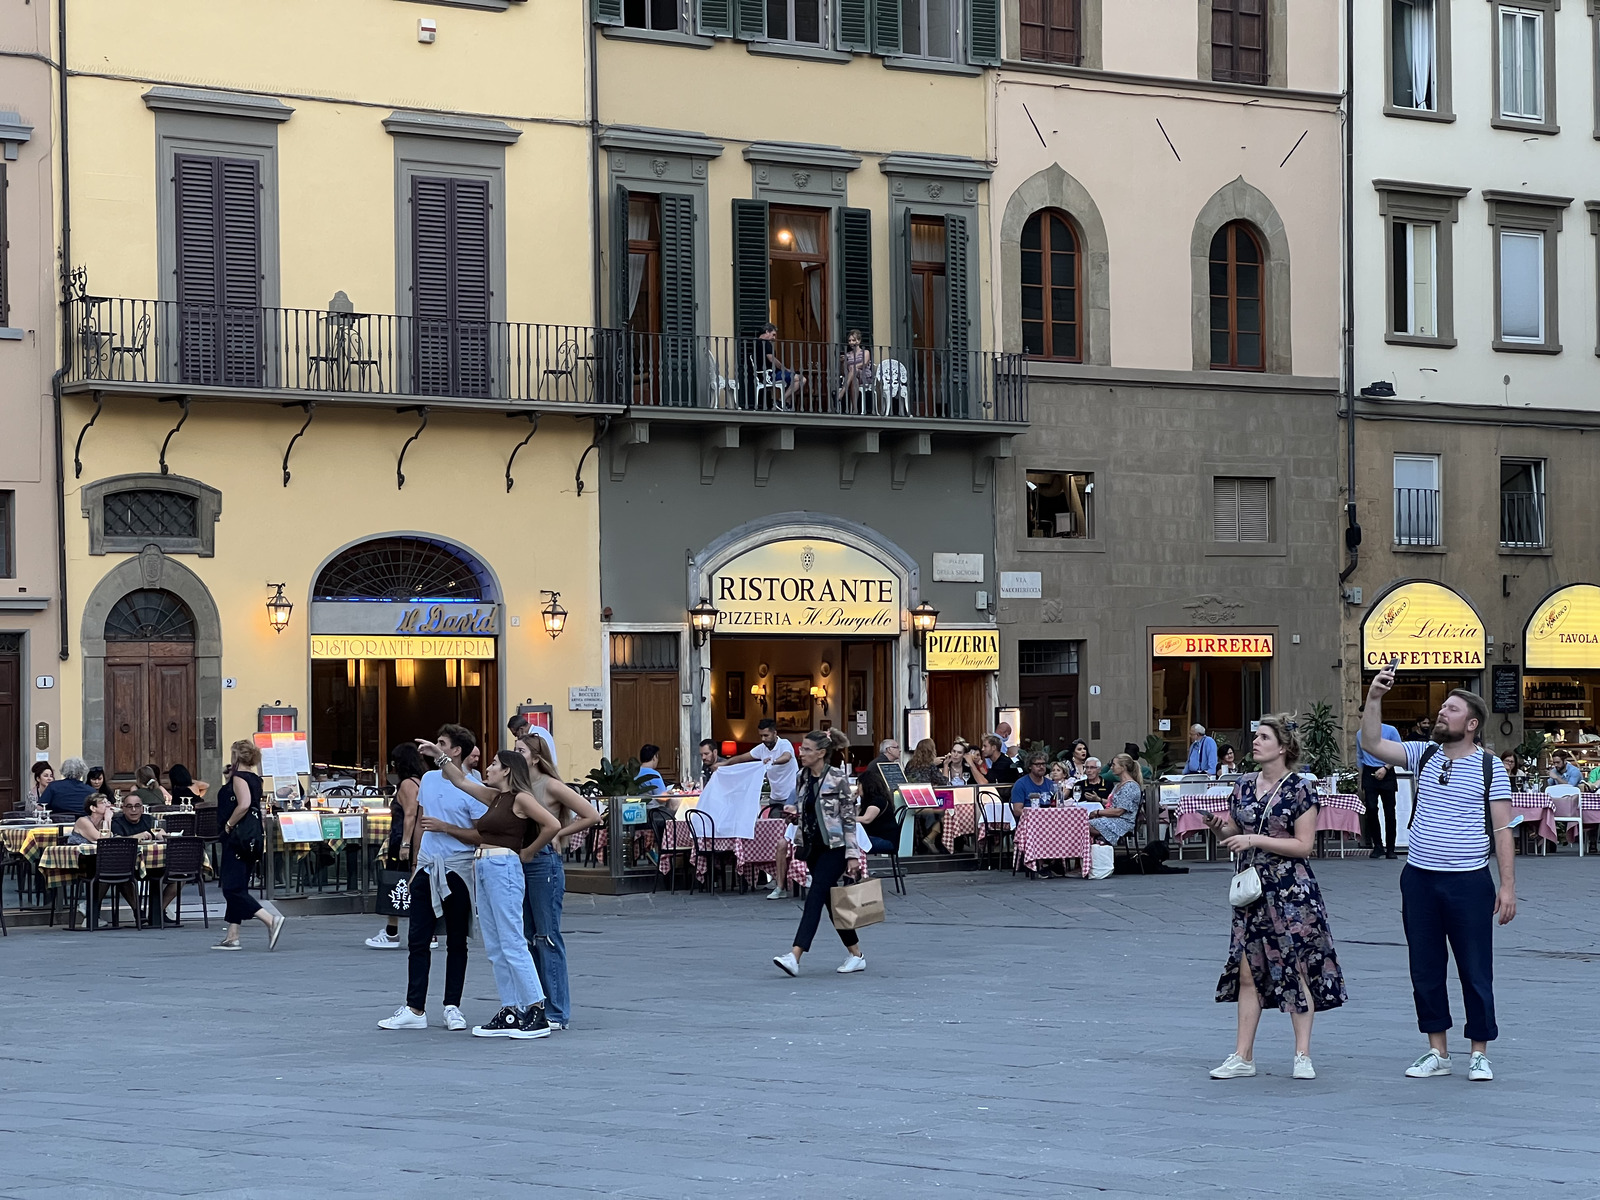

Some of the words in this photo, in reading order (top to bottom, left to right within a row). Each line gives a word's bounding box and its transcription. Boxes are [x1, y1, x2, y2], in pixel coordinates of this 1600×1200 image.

[718, 576, 893, 603] RISTORANTE
[419, 604, 496, 633] David
[718, 611, 792, 626] PIZZERIA
[824, 607, 892, 632] Bargello
[1408, 617, 1479, 639] Letizia
[312, 638, 414, 656] RISTORANTE
[421, 639, 492, 656] PIZZERIA
[929, 635, 997, 653] PIZZERIA
[1185, 638, 1272, 653] BIRRERIA
[1559, 633, 1599, 644] TAVOLA
[1367, 651, 1482, 665] CAFFETTERIA
[226, 678, 232, 688] 2
